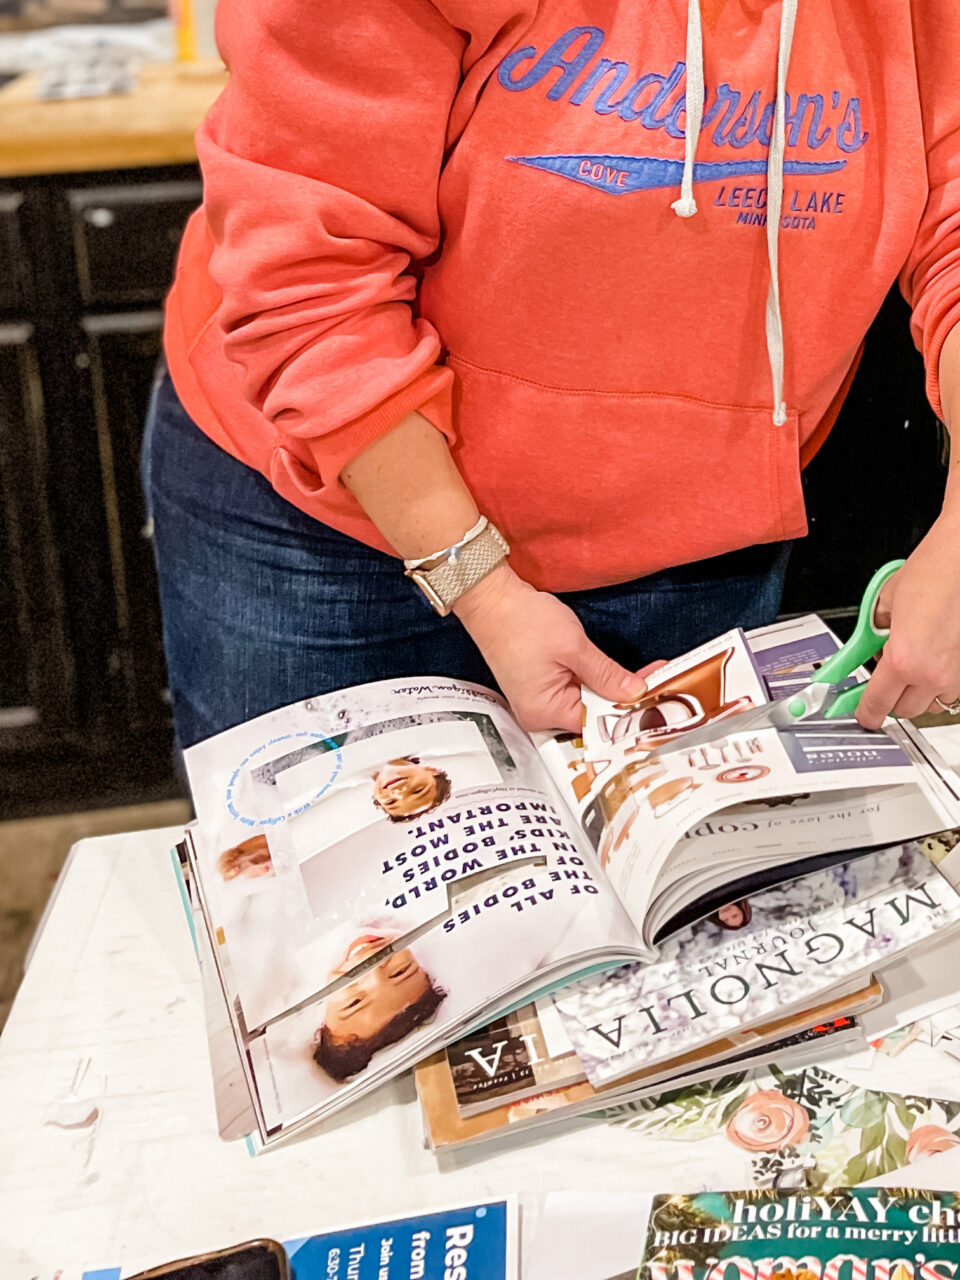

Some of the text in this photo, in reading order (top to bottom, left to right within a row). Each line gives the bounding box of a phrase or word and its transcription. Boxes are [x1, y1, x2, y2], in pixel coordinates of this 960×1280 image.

[497, 25, 869, 154] Anderson's
[577, 159, 630, 188] COVE
[715, 185, 846, 214] LEEC LAKE
[735, 211, 816, 231] MINSOTA
[392, 686, 432, 696] Water
[432, 684, 496, 703] Culligan
[805, 748, 879, 760] notes
[407, 802, 555, 839] IMPORTANT.
[766, 819, 782, 829] of
[789, 816, 820, 827] love
[828, 812, 851, 822] the
[860, 804, 881, 816] for
[382, 814, 561, 874] ARE THE MOST
[402, 828, 570, 883] KIDS' BODIES
[556, 856, 584, 866] OF
[384, 842, 576, 910] IN THE WORLD,
[442, 870, 593, 933] THE BODIES
[510, 884, 599, 912] OF ALL
[697, 920, 816, 976] JOURNAL
[586, 882, 942, 1050] MAGNOLIA
[733, 1196, 899, 1224] holiYAY
[652, 1229, 697, 1247] BIG
[703, 1223, 781, 1243] IDEAS
[787, 1223, 822, 1239] for
[825, 1226, 839, 1239] a
[845, 1226, 918, 1245] merry
[380, 1237, 394, 1266] Join
[410, 1230, 431, 1280] from
